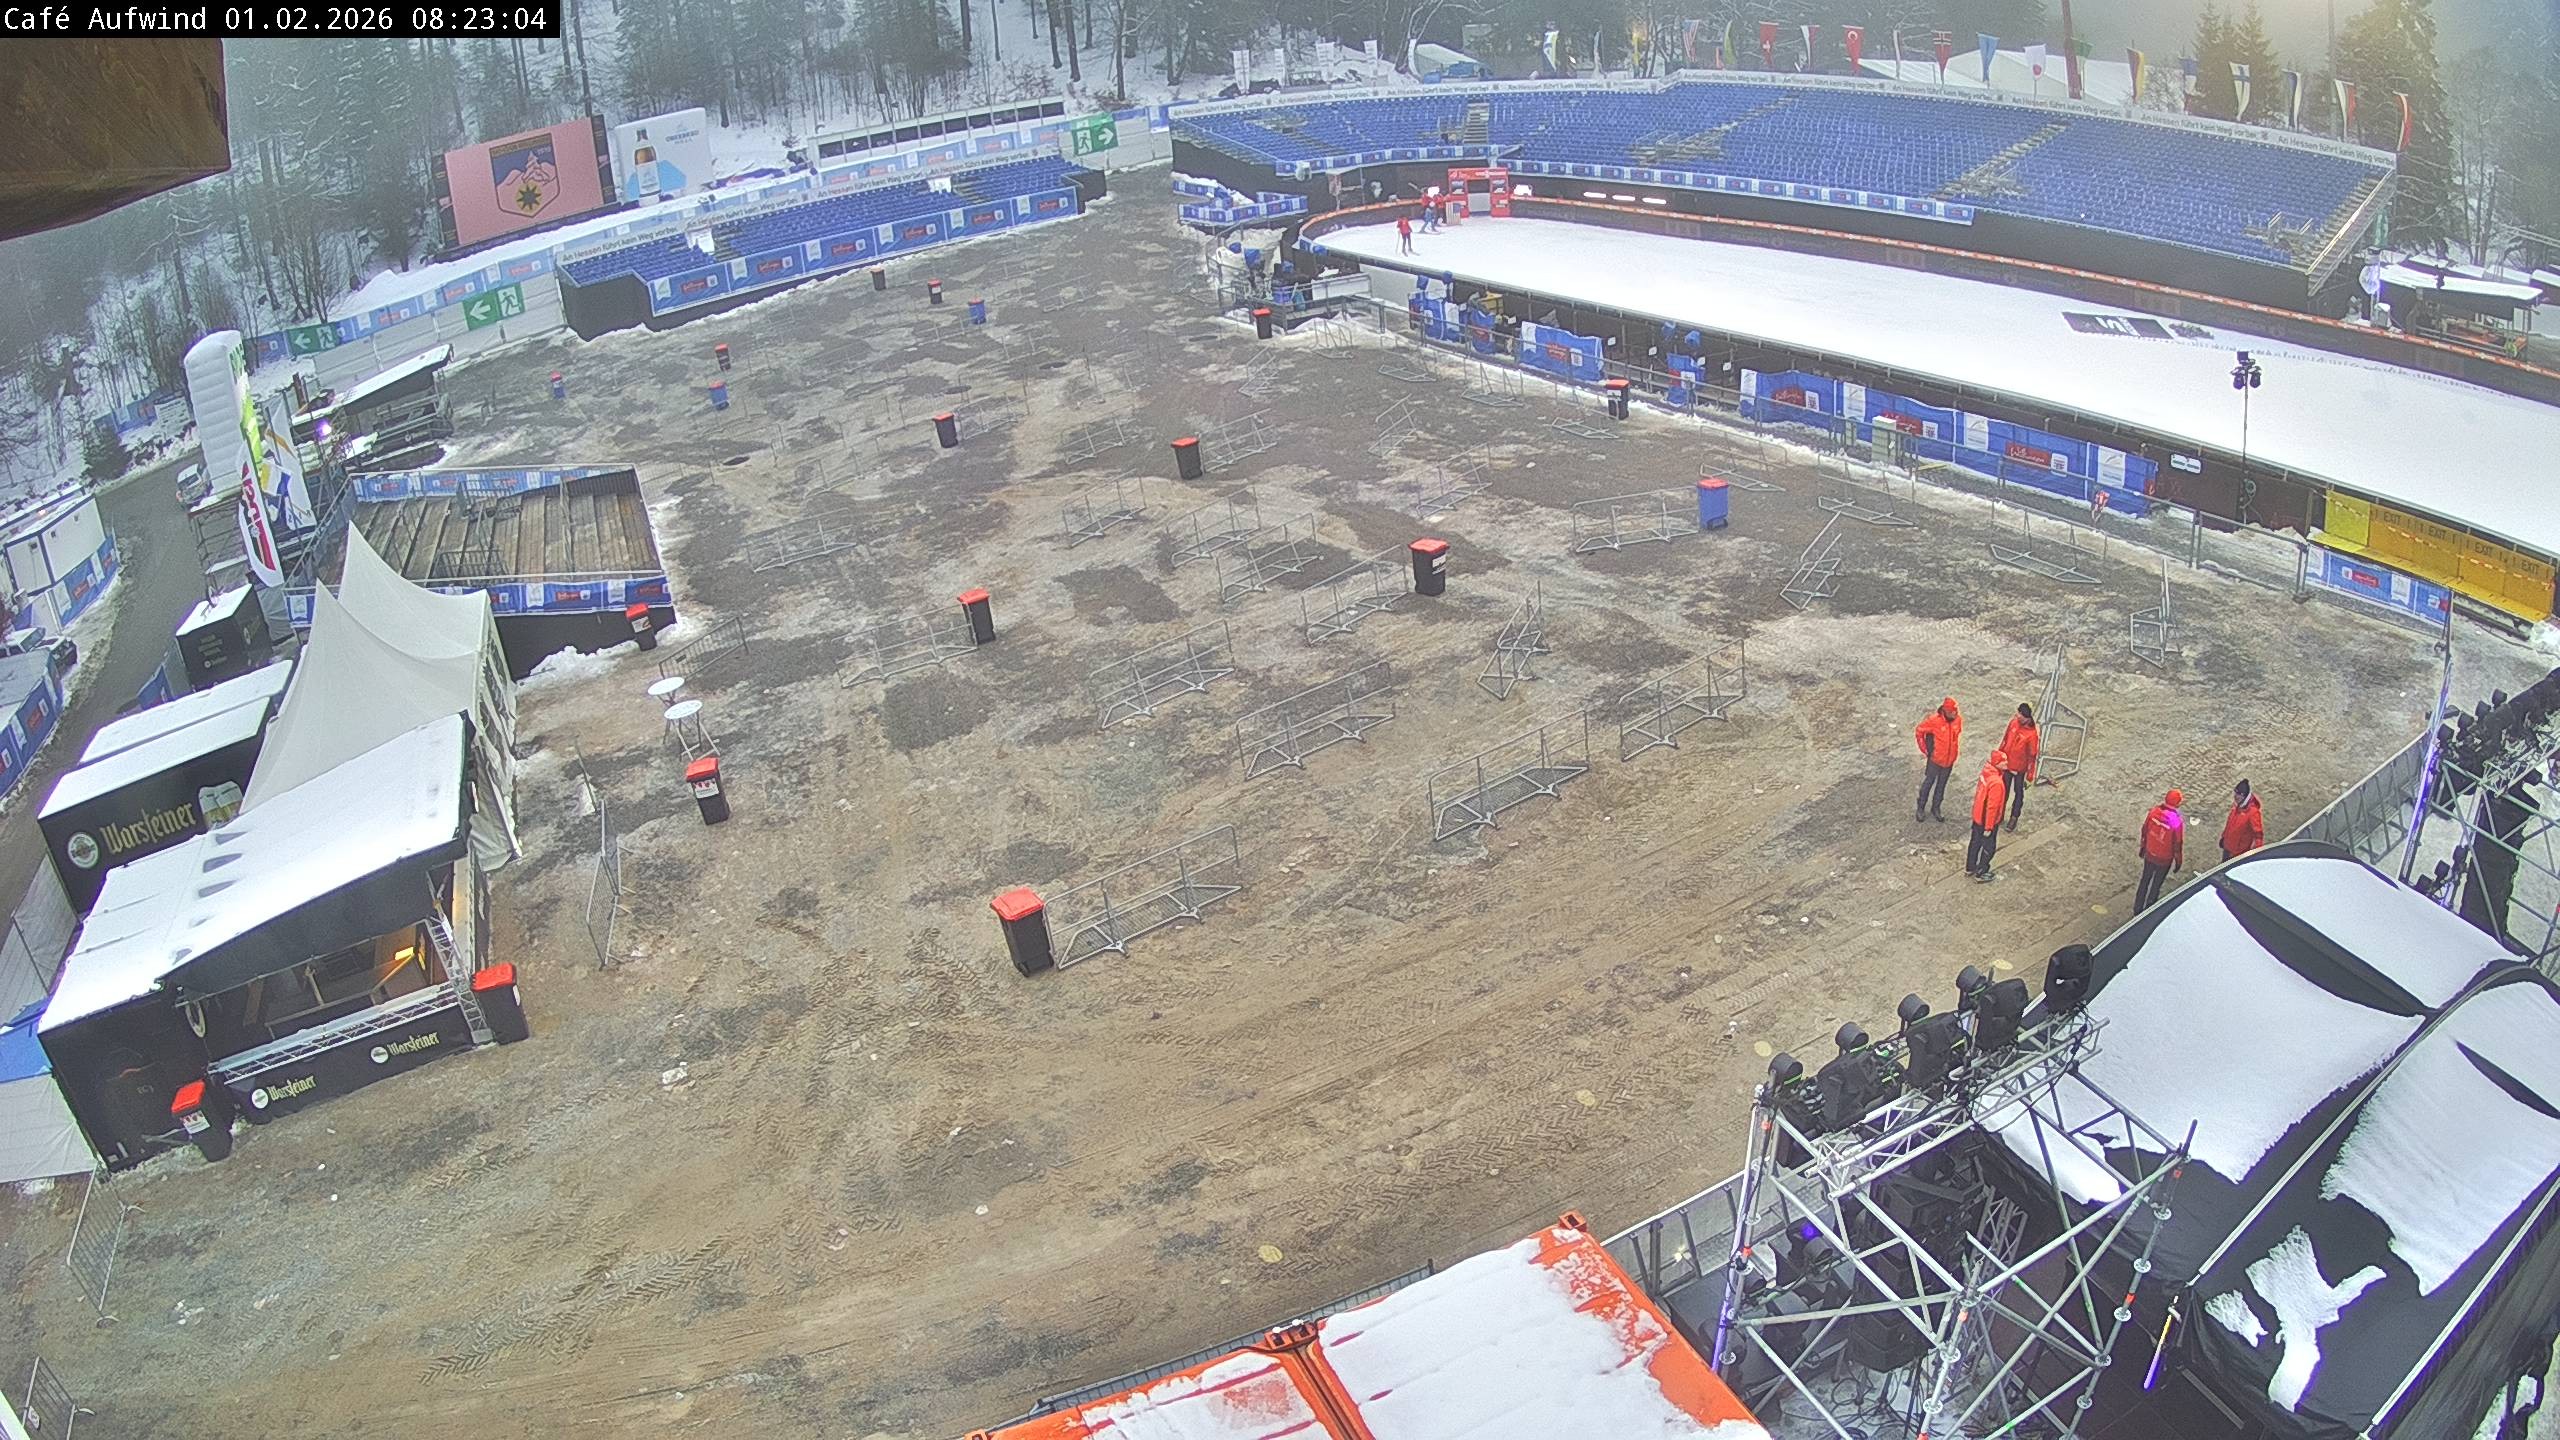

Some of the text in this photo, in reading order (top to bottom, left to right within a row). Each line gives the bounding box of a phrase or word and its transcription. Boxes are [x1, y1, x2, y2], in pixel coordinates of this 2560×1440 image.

[2384, 511, 2401, 525] EXIT
[2428, 525, 2446, 539] EXIT
[2475, 542, 2493, 556] EXIT
[2521, 560, 2539, 574] EXIT
[100, 802, 196, 855] Warsteiner
[388, 1031, 442, 1057] Warsteiner
[268, 1075, 316, 1103] Warsteiner
